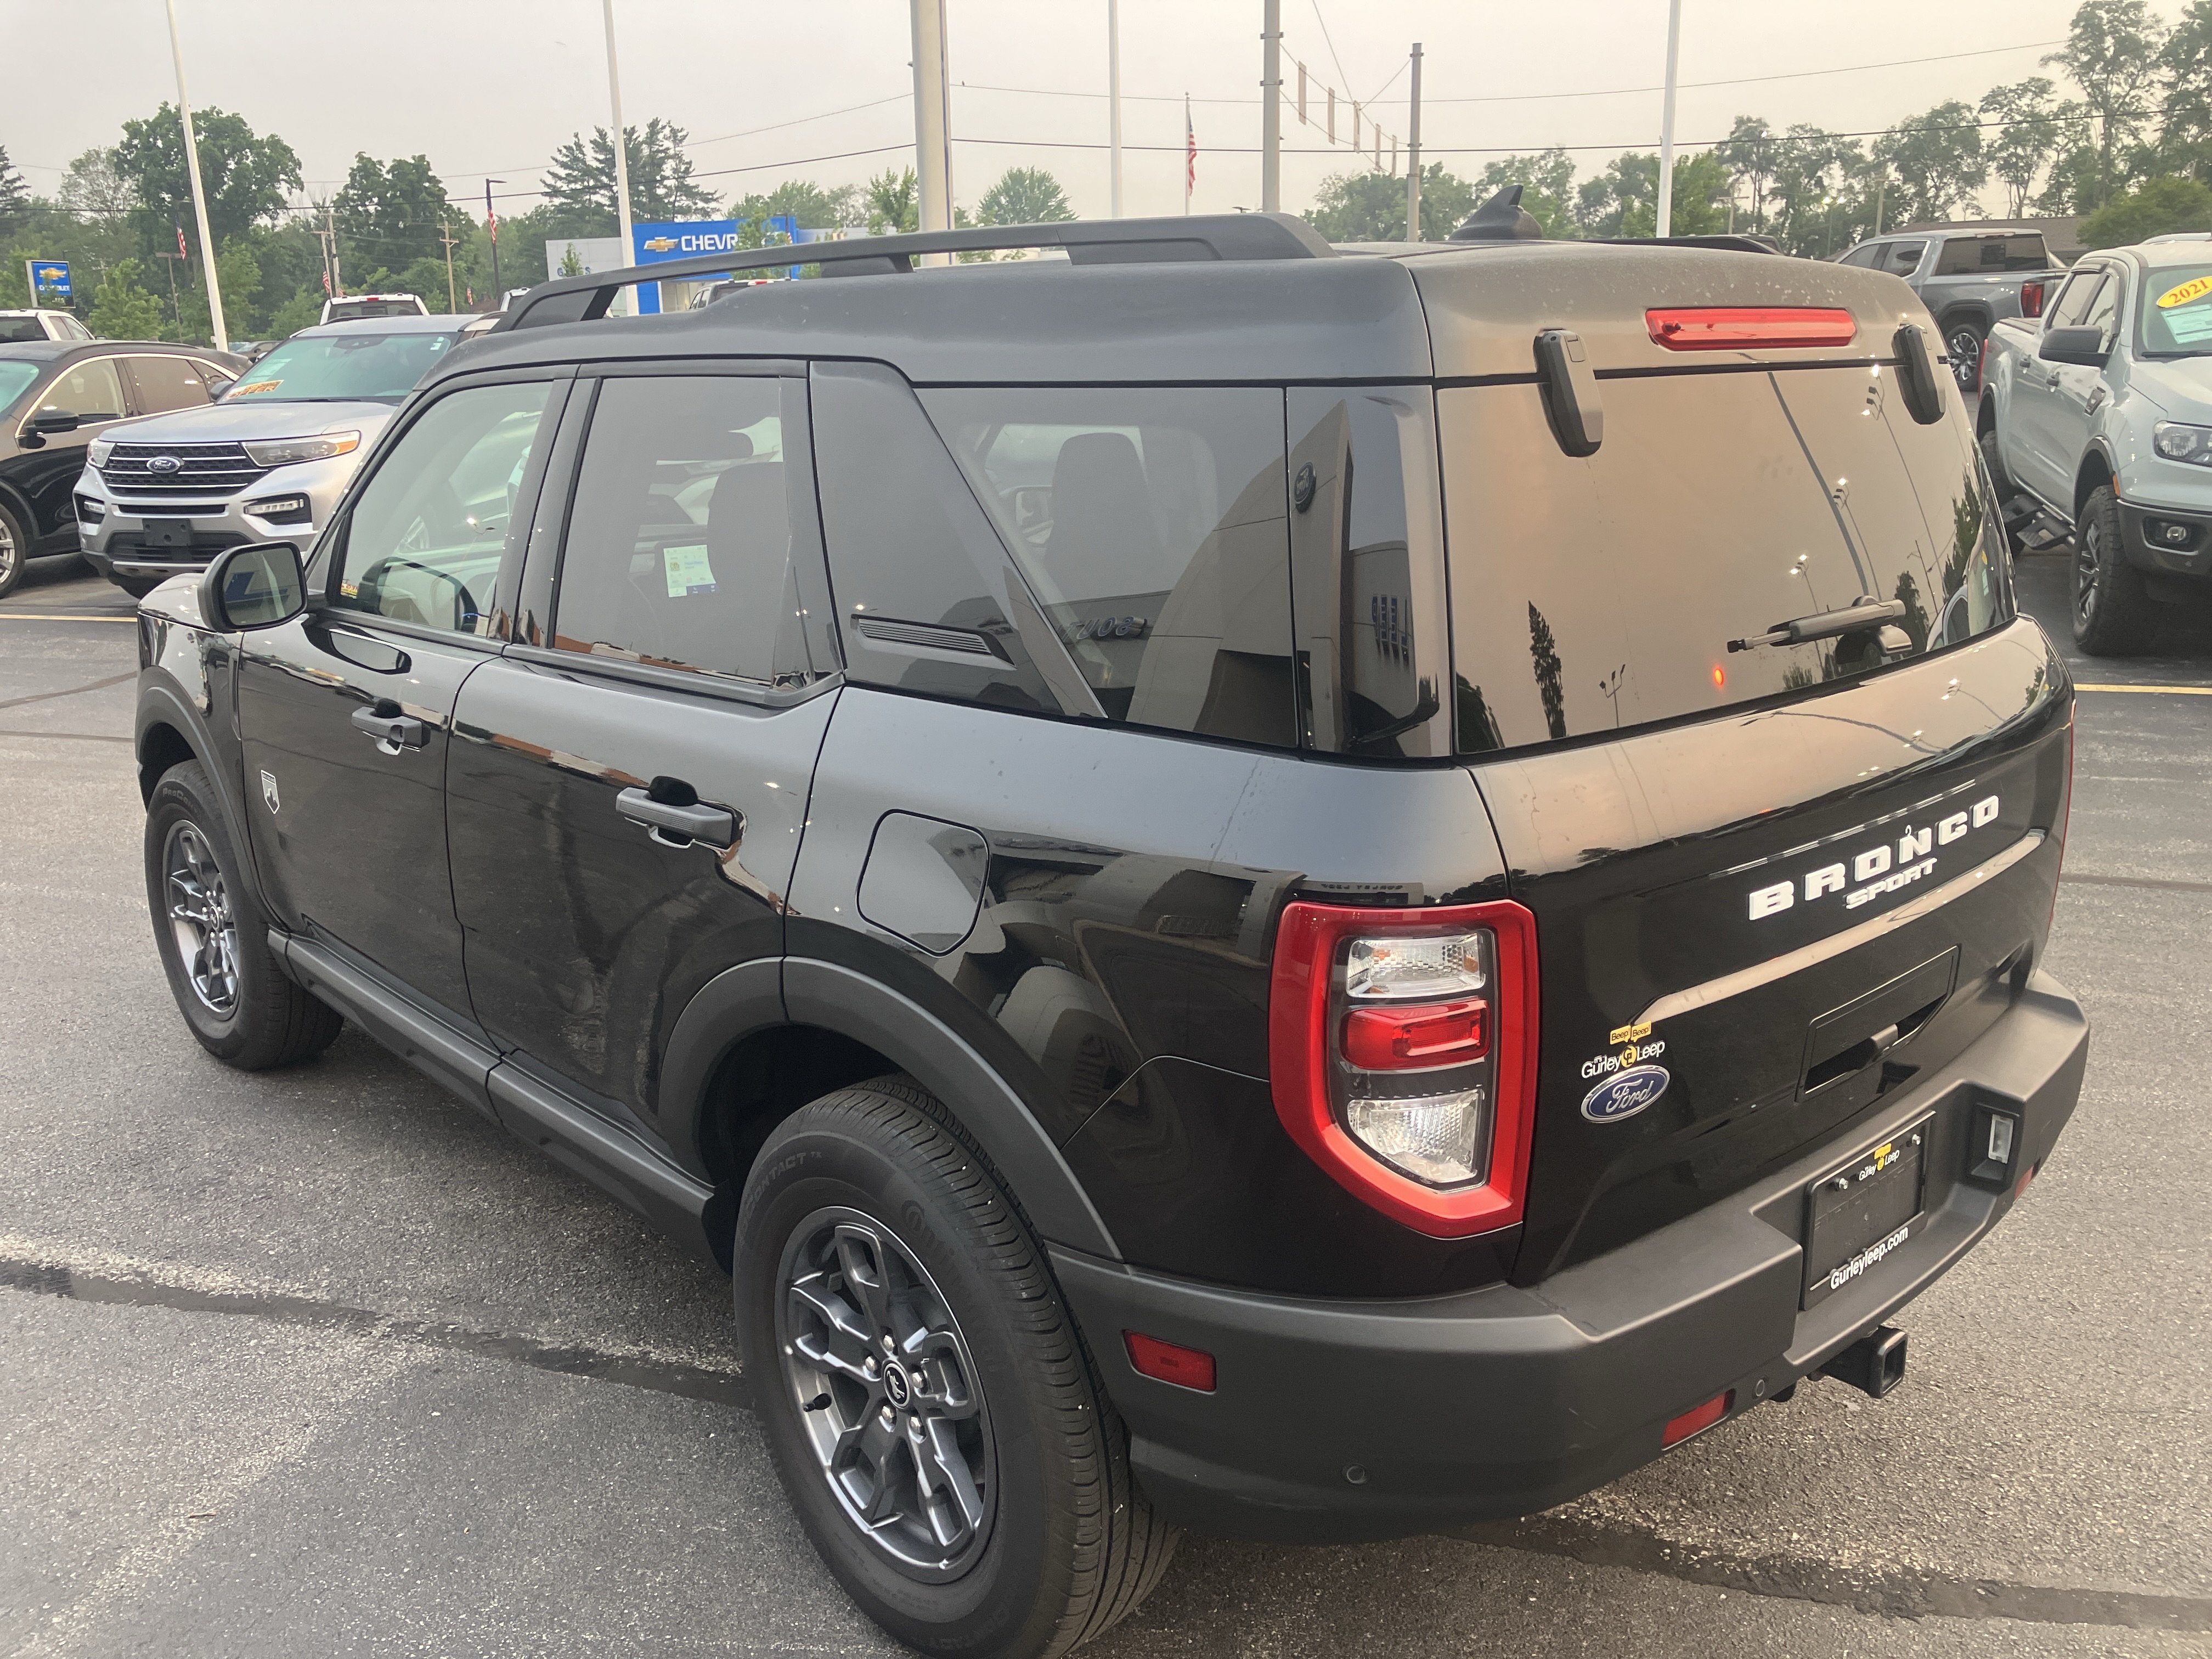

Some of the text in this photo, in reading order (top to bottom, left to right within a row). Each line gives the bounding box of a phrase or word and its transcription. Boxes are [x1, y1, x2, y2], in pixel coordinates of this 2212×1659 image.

[2169, 280, 2209, 303] 2021
[1748, 794, 1999, 921] BRONCO
[1846, 857, 1938, 910] SPORT
[1611, 1024, 1650, 1041] Beep! Beep!
[1582, 1054, 1622, 1079] Gurley
[1637, 1041, 1666, 1062] Leep
[1606, 1078, 1655, 1113] Ford
[1884, 1149, 1900, 1166] Leep
[1830, 1227, 1909, 1289] Gurleyleep.com
